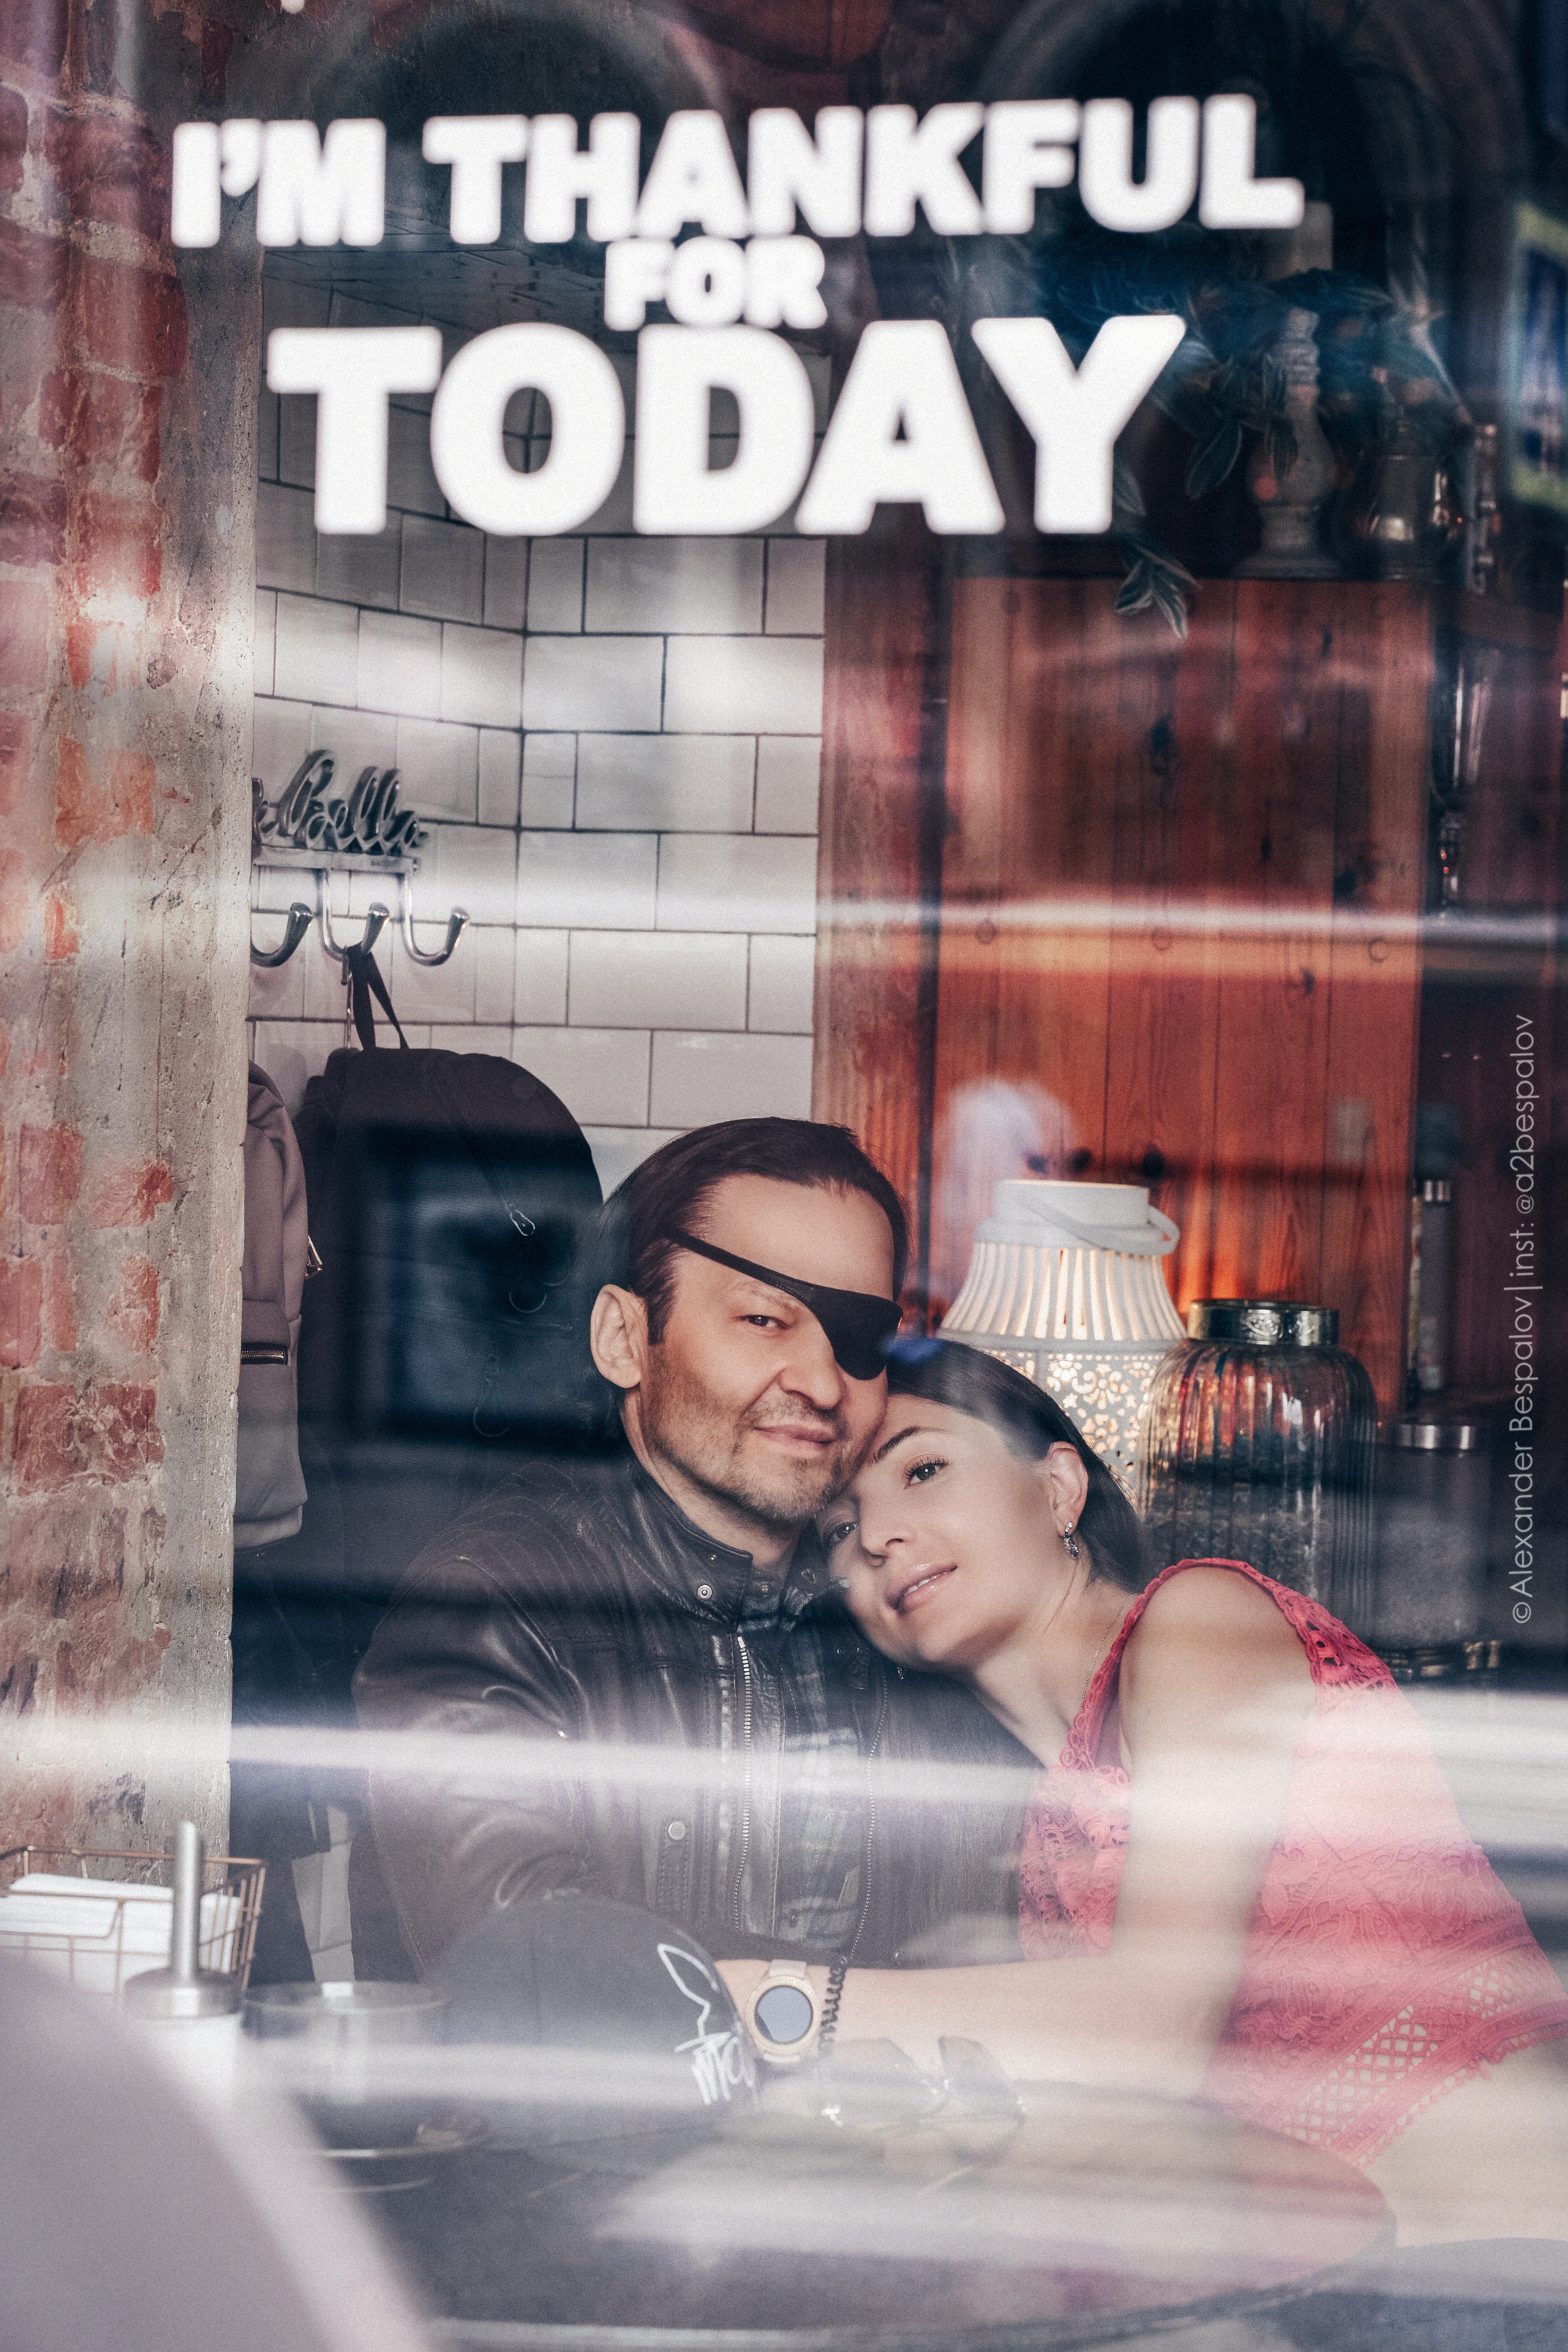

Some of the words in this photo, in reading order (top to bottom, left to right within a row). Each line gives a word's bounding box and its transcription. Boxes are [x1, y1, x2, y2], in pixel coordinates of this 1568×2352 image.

[421, 94, 1305, 243] THANKFUL
[602, 235, 829, 332] FOR
[266, 314, 1187, 536] TODAY
